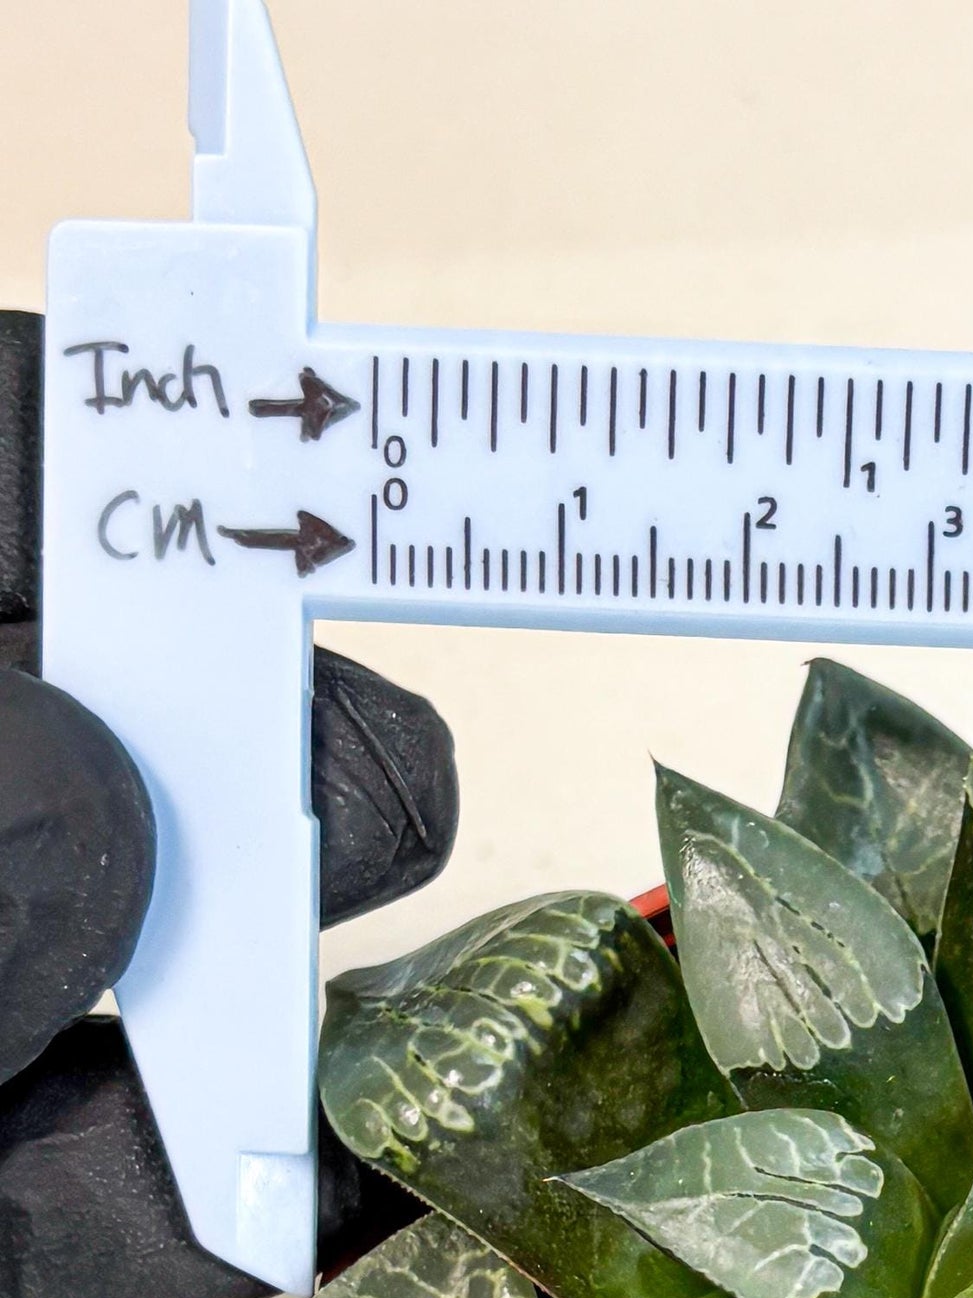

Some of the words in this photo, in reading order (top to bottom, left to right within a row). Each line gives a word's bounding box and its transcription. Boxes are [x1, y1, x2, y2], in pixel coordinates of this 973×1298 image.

[63, 341, 230, 418] Inch
[383, 435, 407, 469] 0
[860, 461, 877, 493] 1
[382, 477, 409, 511] 0
[572, 486, 588, 521] 1
[755, 495, 778, 530] 2
[942, 505, 964, 538] 3
